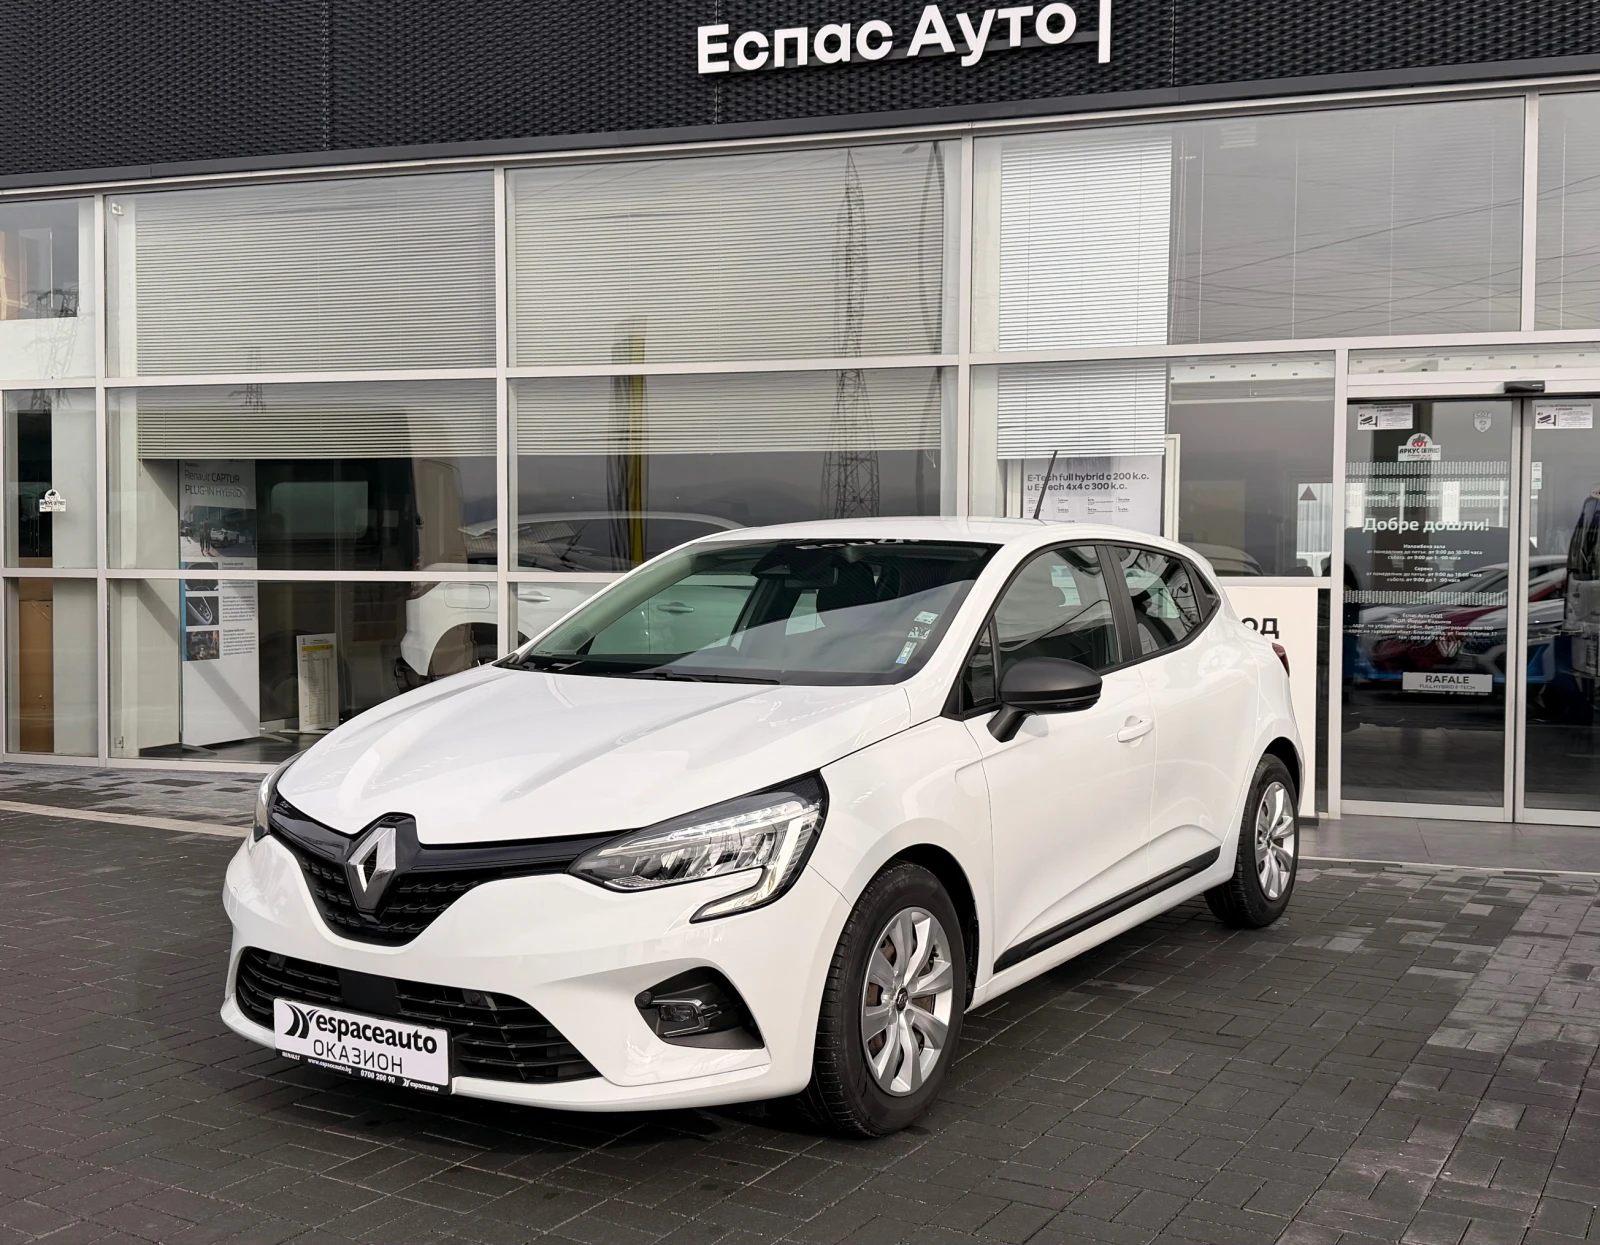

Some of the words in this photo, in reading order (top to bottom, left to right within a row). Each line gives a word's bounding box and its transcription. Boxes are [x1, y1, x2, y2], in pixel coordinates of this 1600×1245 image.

[698, 19, 895, 74] Еспас
[906, 3, 1078, 68] Ауто
[184, 469, 211, 482] Renault
[211, 472, 240, 484] CAPTUR
[1059, 473, 1074, 481] full
[1075, 472, 1105, 483] hybrid
[1113, 472, 1131, 480] 200
[184, 484, 215, 496] PLUG-IN
[215, 486, 242, 498] HYBRID
[1034, 482, 1065, 491] E-ech
[1091, 482, 1110, 490] 300
[1362, 517, 1419, 534] Добре
[1423, 518, 1490, 533] дошли!
[1425, 675, 1470, 684] RAFALE
[315, 1013, 438, 1053] espaceauto
[313, 1039, 403, 1075] ОКАЗИОН
[360, 1069, 375, 1079] 0700
[375, 1073, 387, 1082] 200
[387, 1076, 396, 1084] 90
